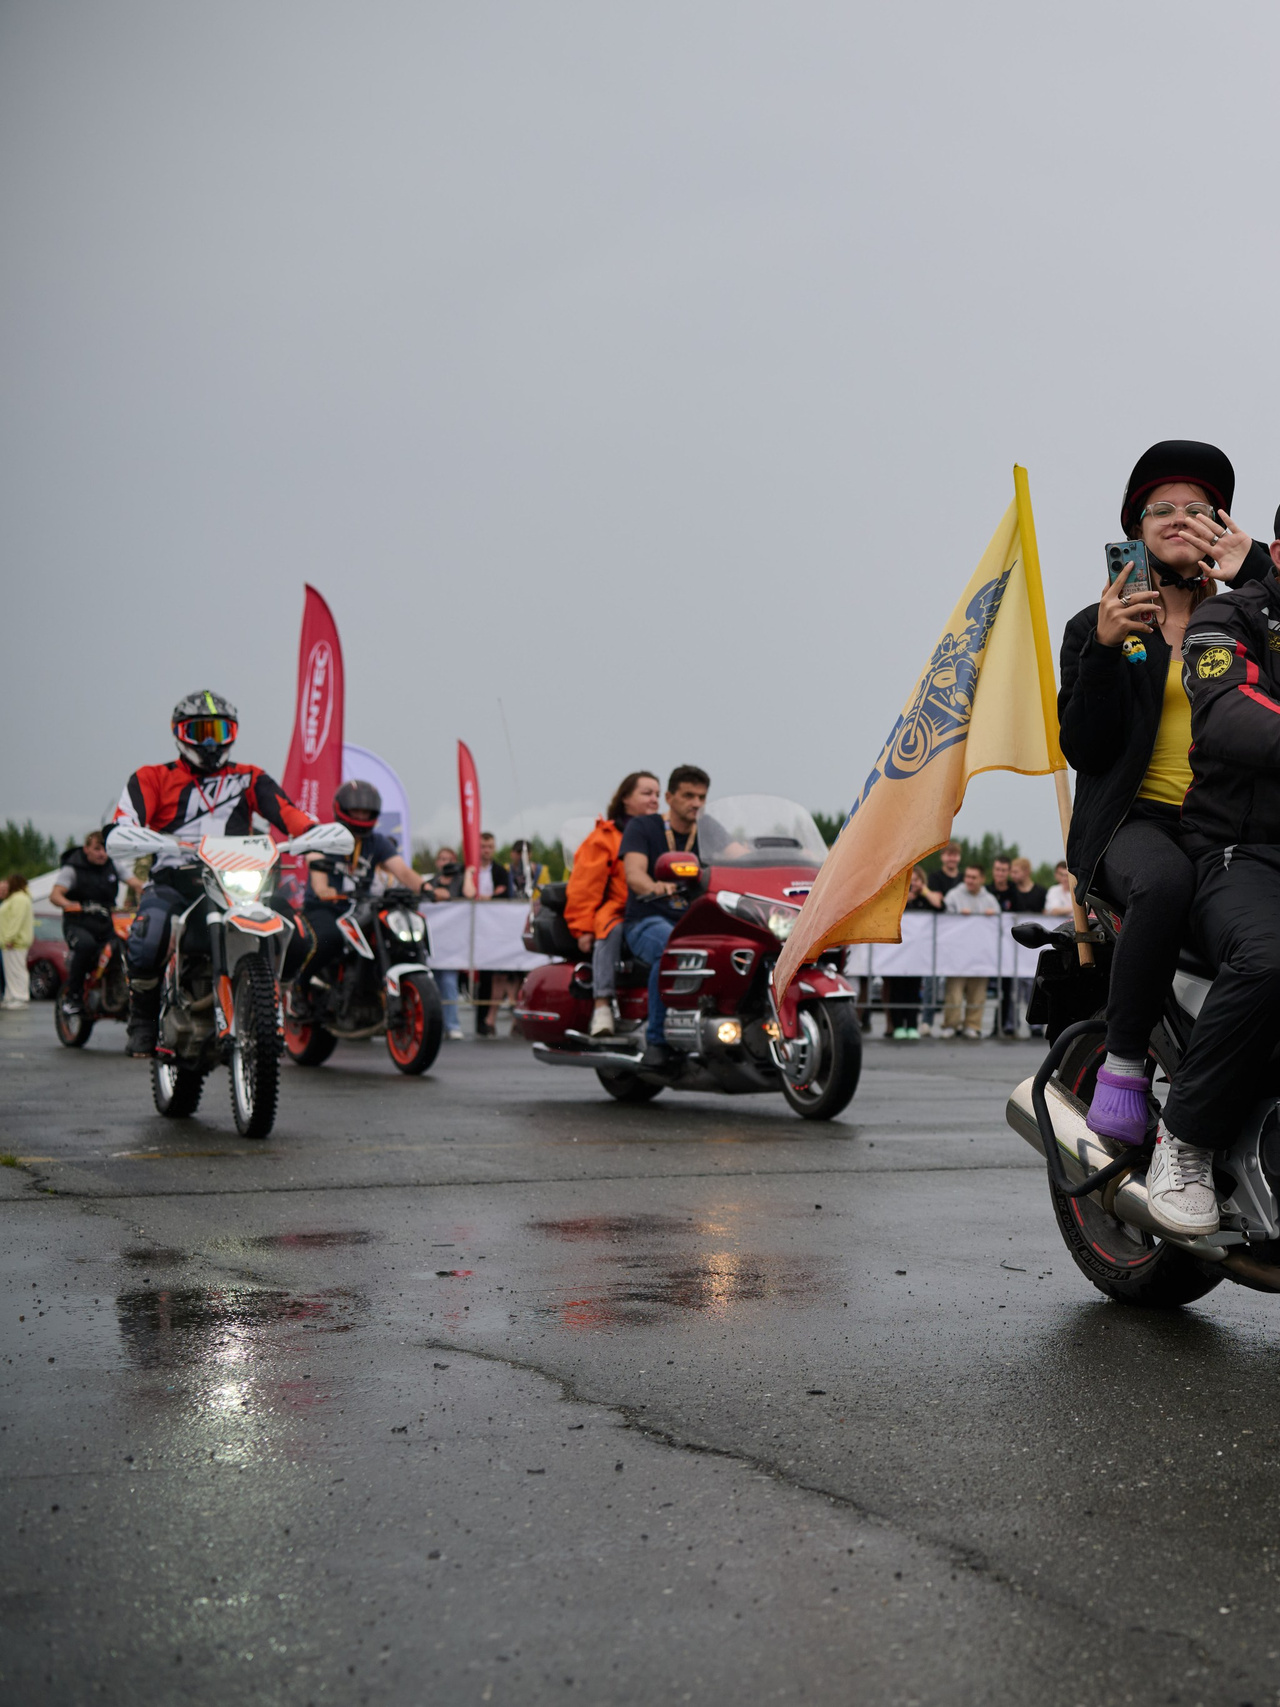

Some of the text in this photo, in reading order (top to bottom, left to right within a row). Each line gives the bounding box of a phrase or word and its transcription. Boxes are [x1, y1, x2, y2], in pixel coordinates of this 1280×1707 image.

[304, 650, 330, 755] SINTEC
[1063, 1214, 1082, 1248] 170/60
[1080, 1247, 1118, 1278] MICHELIN
